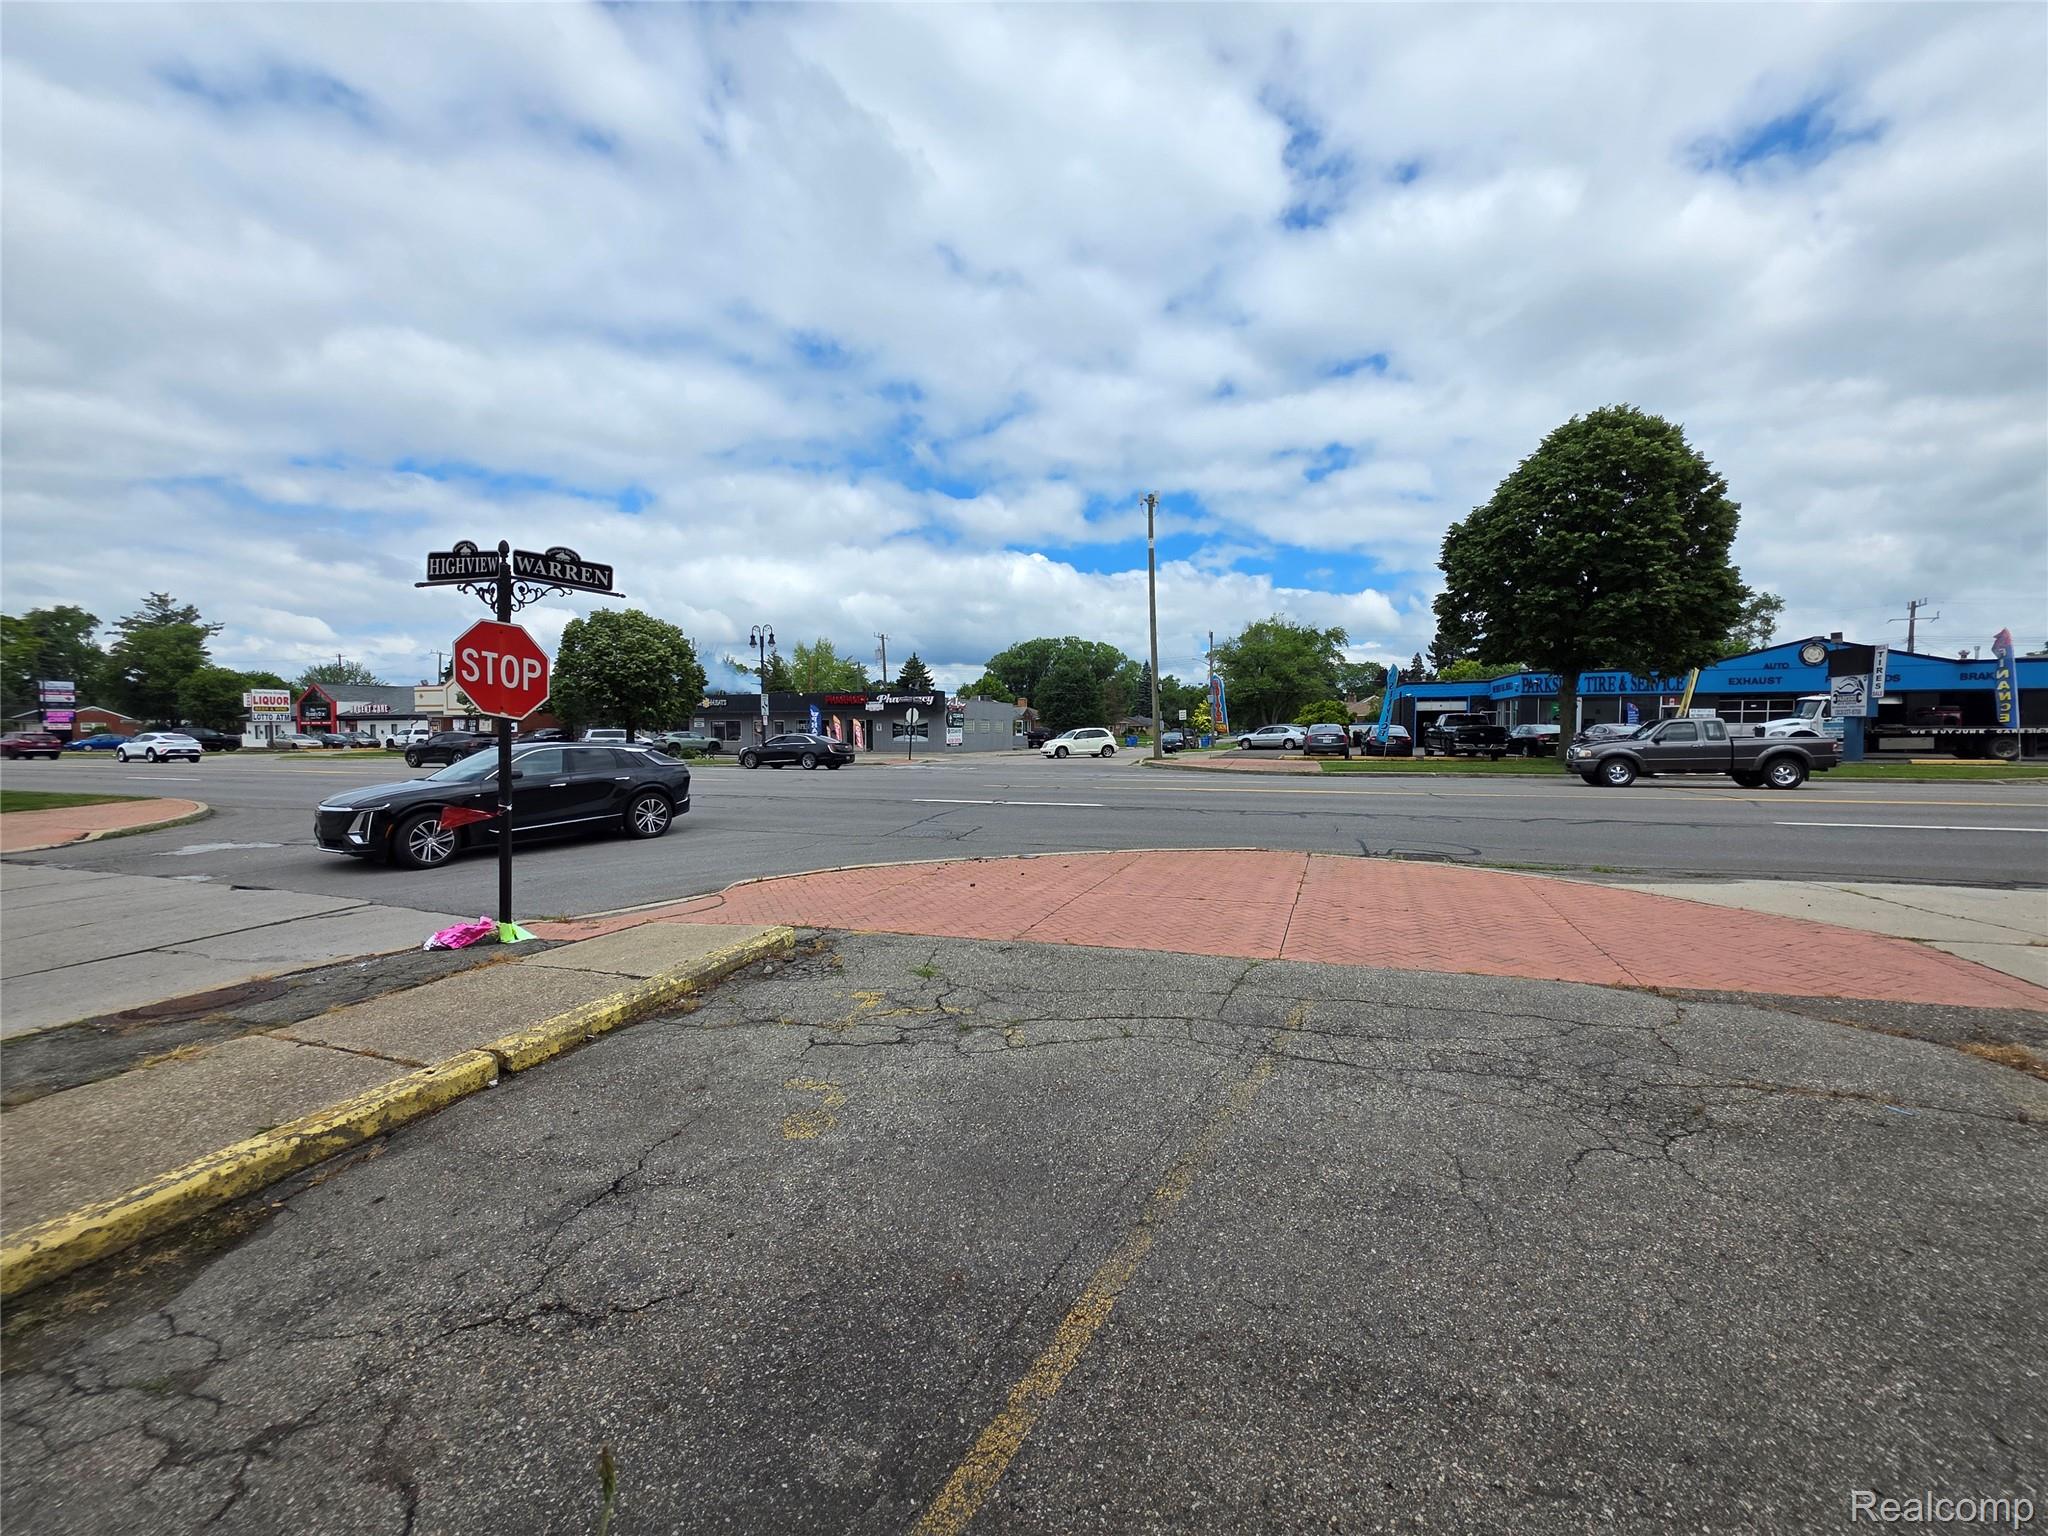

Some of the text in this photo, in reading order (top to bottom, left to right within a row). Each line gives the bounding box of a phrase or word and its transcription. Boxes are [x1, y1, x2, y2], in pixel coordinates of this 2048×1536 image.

[429, 556, 498, 575] HIGHVIEW
[515, 556, 610, 586] WARREN
[461, 647, 542, 691] STOP
[1763, 662, 1790, 670] AUTO
[1874, 651, 1885, 689] TIRES
[1584, 676, 1616, 693] TIRE
[1618, 675, 1627, 692] &
[1728, 676, 1782, 685] EXHAUST
[1959, 672, 1995, 681] BRAK
[253, 696, 289, 705] LIQUOR
